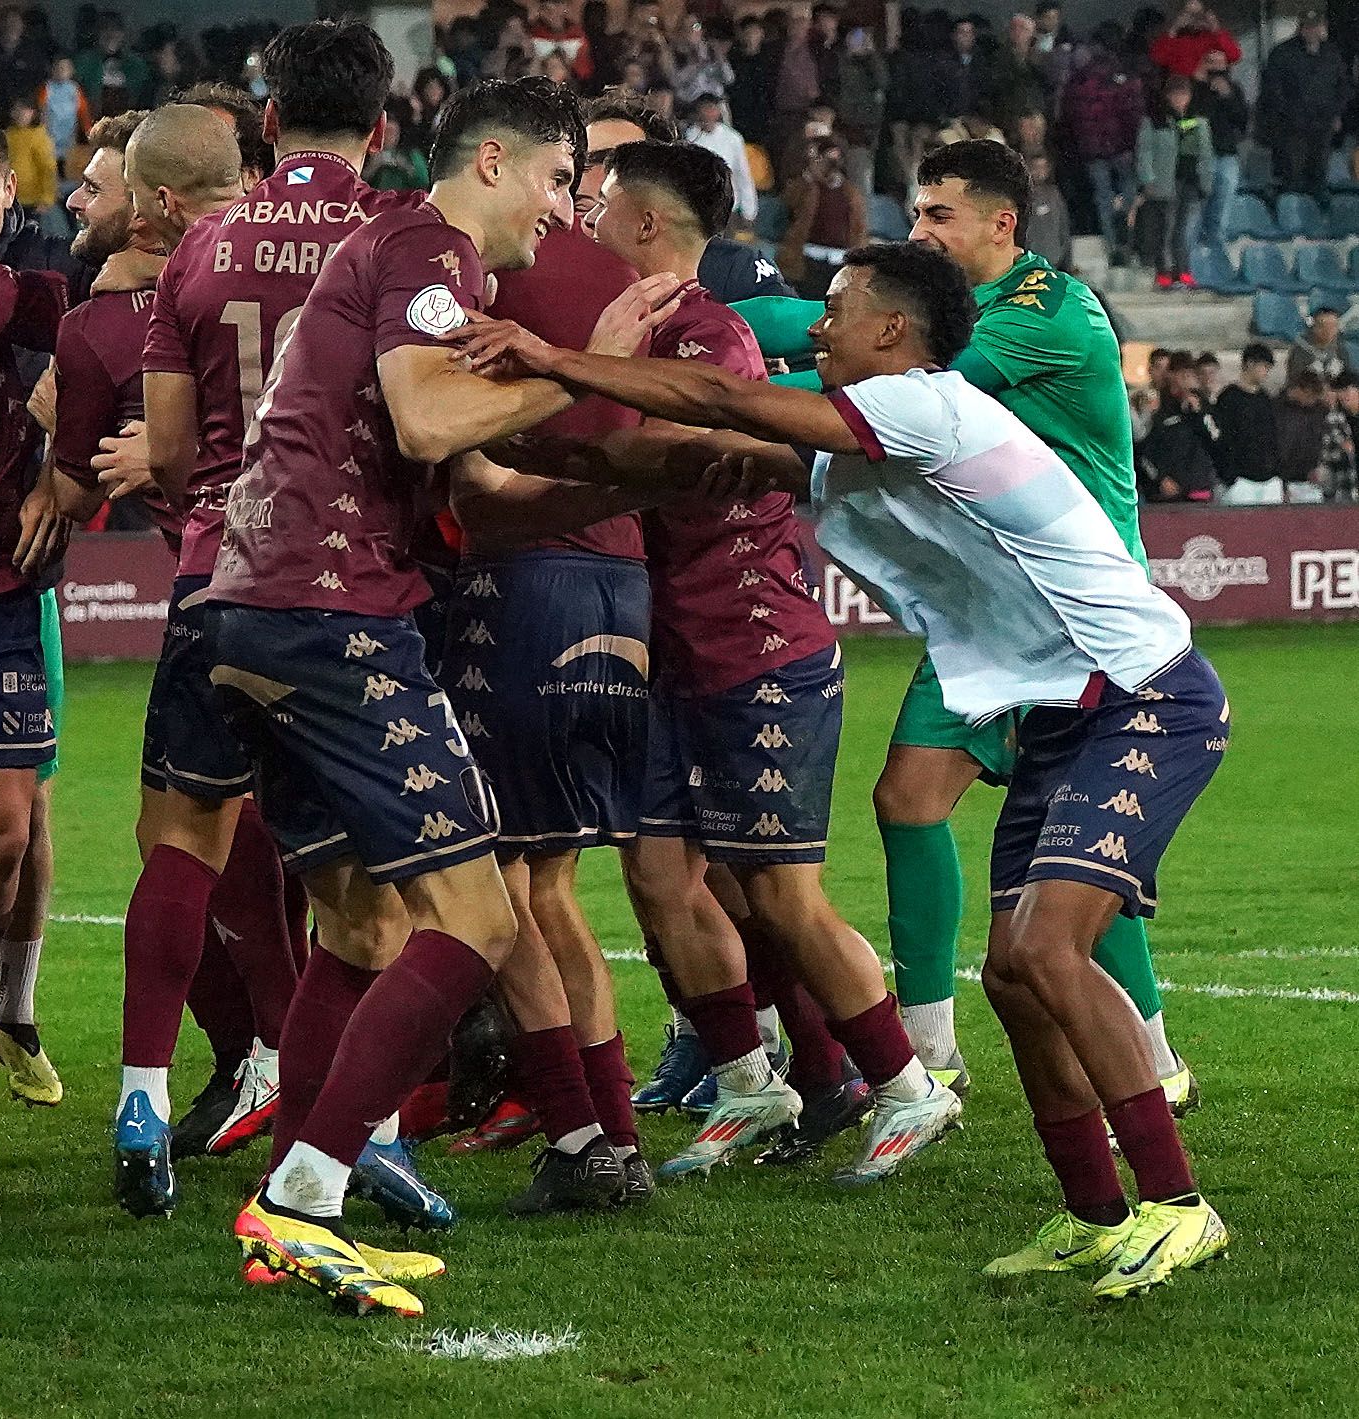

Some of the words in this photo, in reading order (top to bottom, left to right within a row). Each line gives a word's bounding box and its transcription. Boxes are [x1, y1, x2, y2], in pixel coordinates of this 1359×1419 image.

[214, 241, 242, 273] B.
[427, 690, 469, 758] 3
[702, 809, 742, 822] DEPORTE
